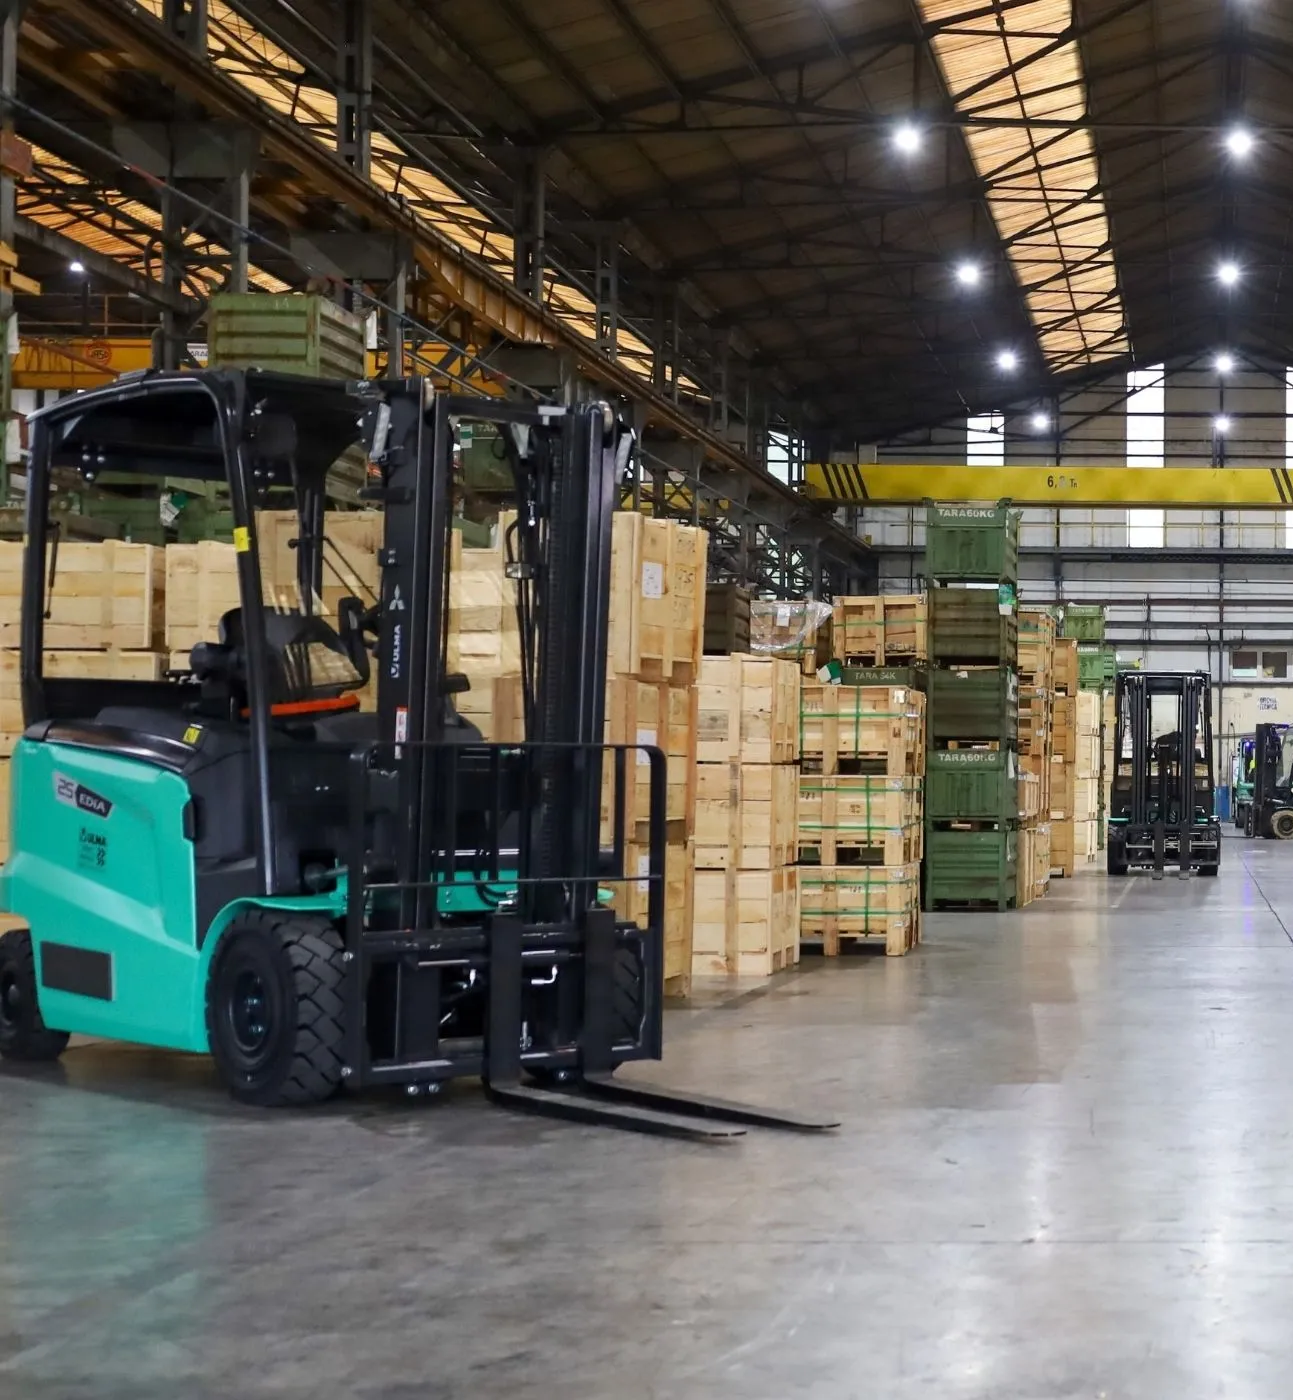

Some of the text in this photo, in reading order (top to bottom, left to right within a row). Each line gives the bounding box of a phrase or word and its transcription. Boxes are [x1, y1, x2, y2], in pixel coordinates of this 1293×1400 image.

[855, 672, 878, 680] TARA
[58, 779, 105, 813] 25 EDIA
